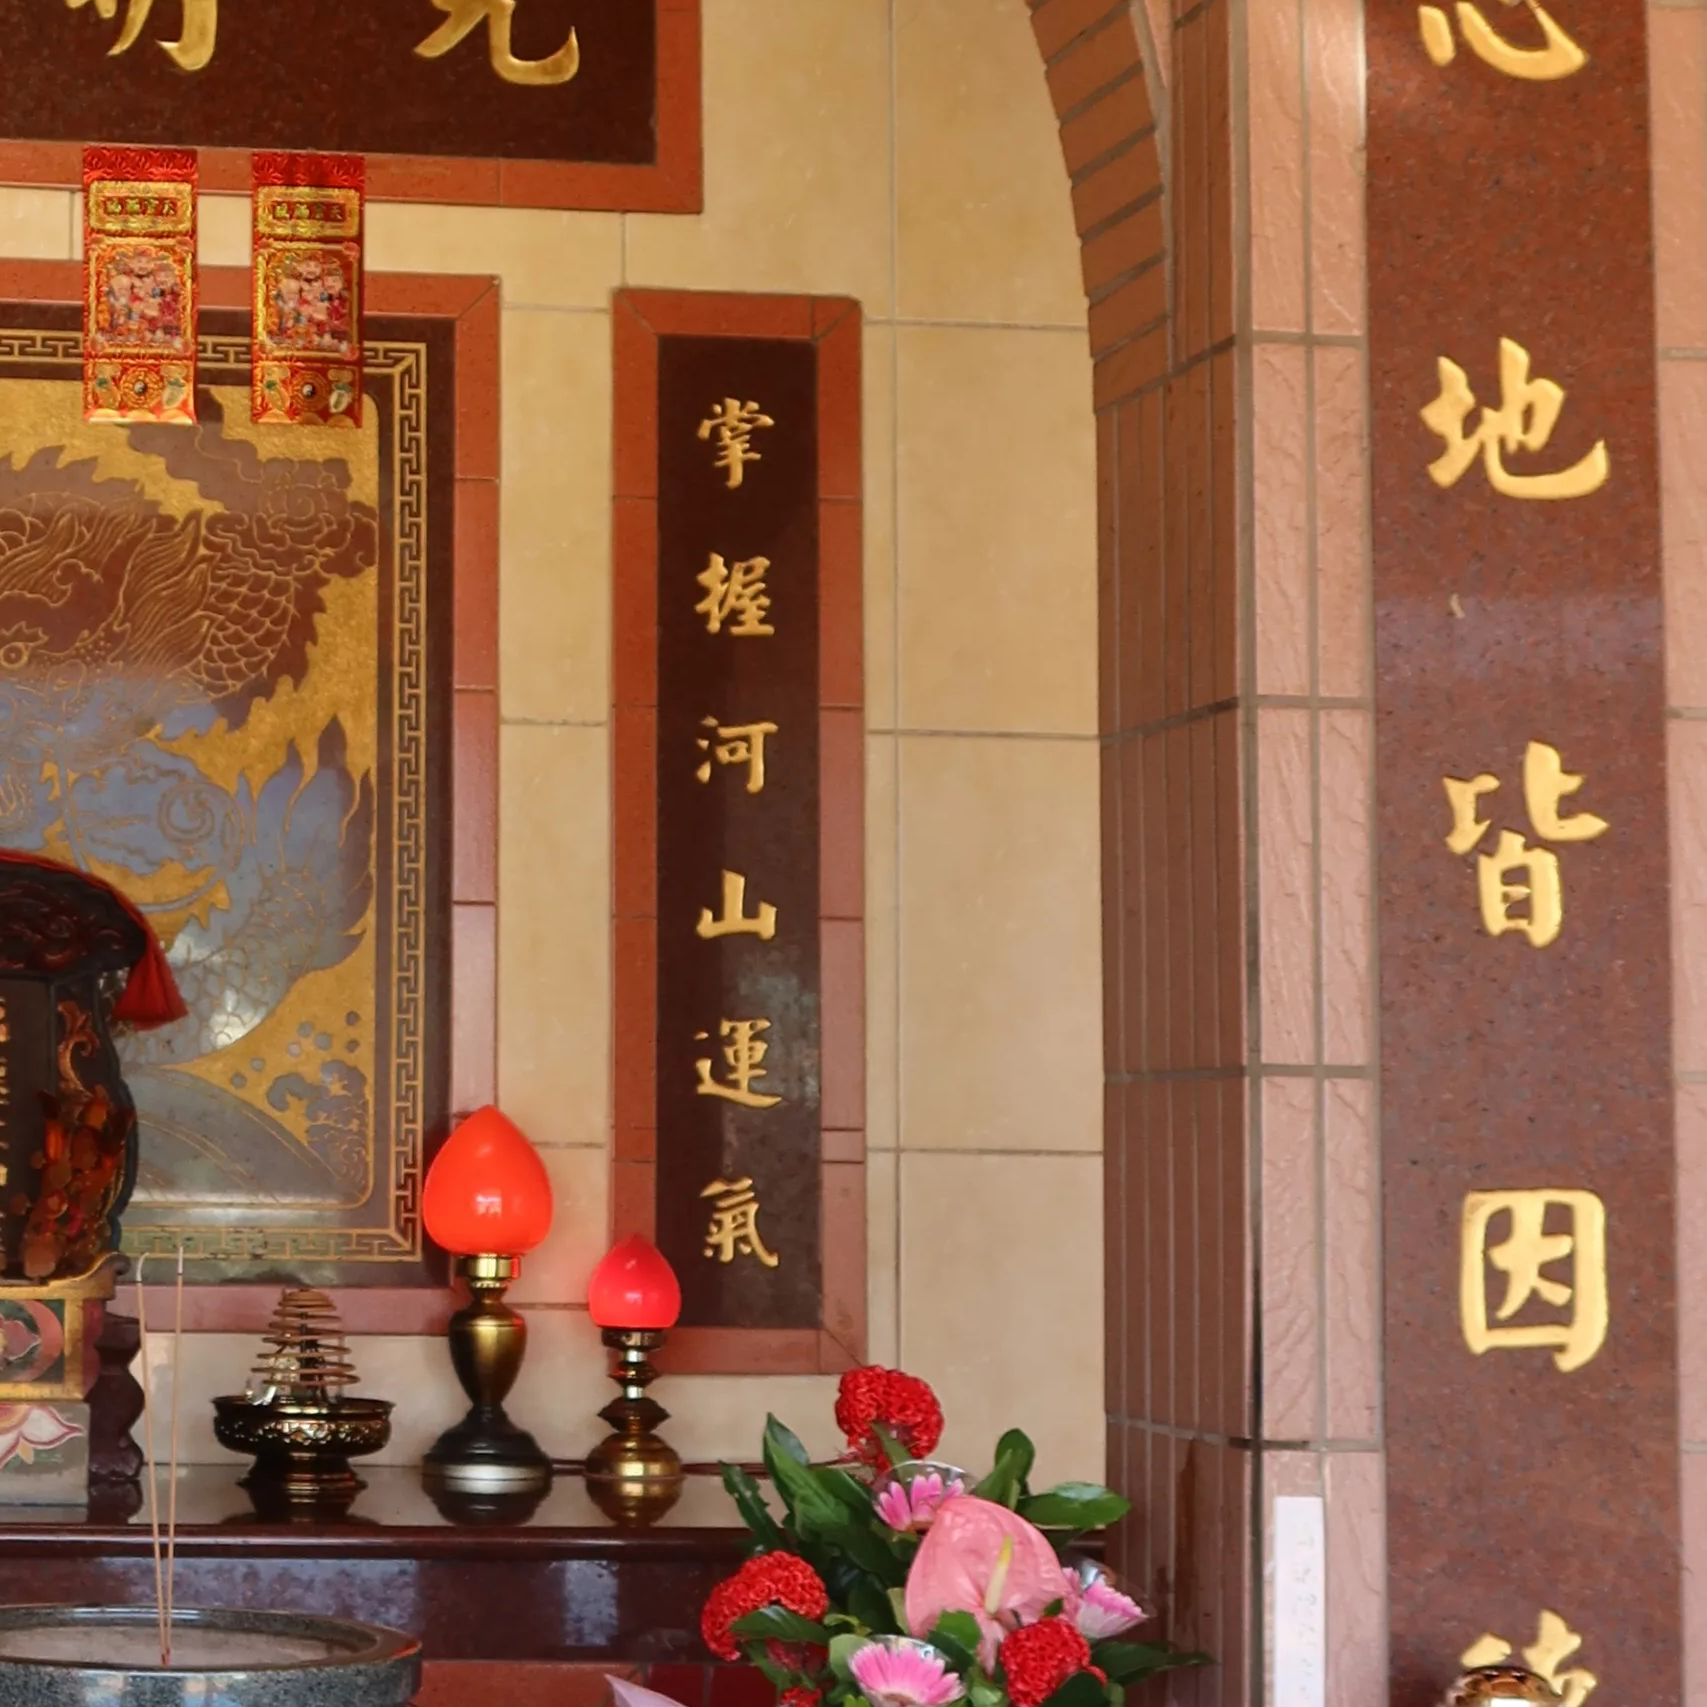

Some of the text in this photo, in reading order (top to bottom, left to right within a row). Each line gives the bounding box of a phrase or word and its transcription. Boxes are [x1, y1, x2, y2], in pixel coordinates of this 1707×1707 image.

[695, 396, 783, 1269] 掌握河山運氣
